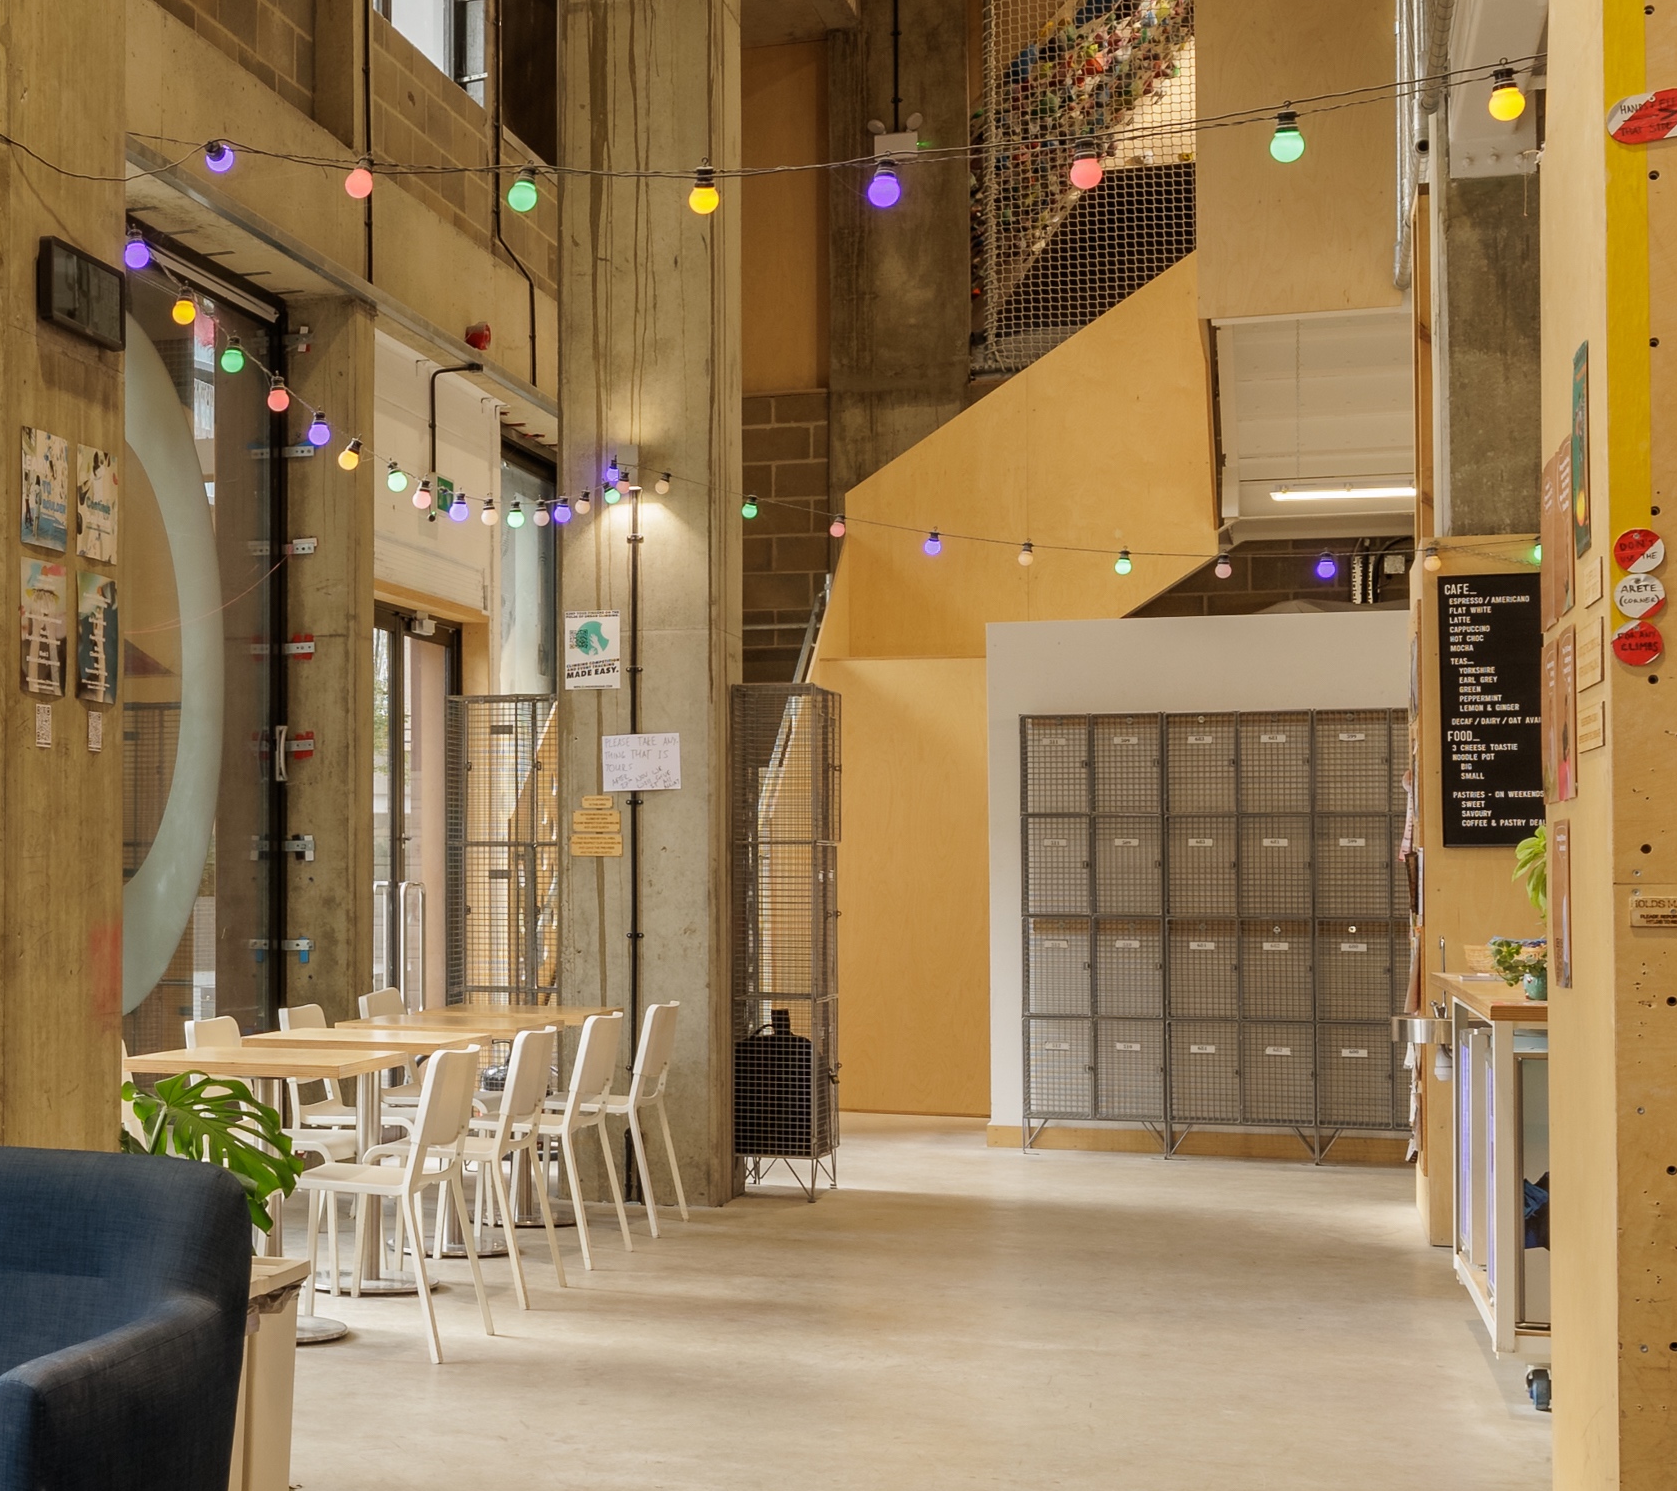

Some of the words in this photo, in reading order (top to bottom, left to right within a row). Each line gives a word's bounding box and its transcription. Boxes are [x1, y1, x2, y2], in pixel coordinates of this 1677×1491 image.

[1621, 584, 1657, 593] ARETE
[1470, 606, 1492, 614] WHITE
[1449, 616, 1471, 624] LATTE
[1449, 625, 1490, 633] CAPPUCCINO
[1450, 644, 1474, 652] MOCHA
[566, 670, 592, 679] MADE
[594, 666, 619, 675] EASY.
[1459, 676, 1476, 684] EARL
[1459, 694, 1502, 703] PEPPERMINT
[1459, 704, 1483, 712] LEMON
[1495, 703, 1520, 711] GINGER
[1480, 717, 1501, 725] DAIRY
[1508, 716, 1522, 724] OAT
[604, 737, 630, 748] PLEASE
[637, 736, 657, 746] TAKE
[1490, 743, 1518, 751] TOASTIE
[604, 751, 626, 759] THING
[631, 749, 652, 759] THAT
[658, 750, 669, 759] IS
[1460, 772, 1485, 780] SMALL
[1453, 791, 1486, 799] PASTRIES
[1461, 800, 1485, 808] SWEET
[1461, 810, 1492, 818] SAVOURY
[1461, 819, 1488, 827] COFFEE
